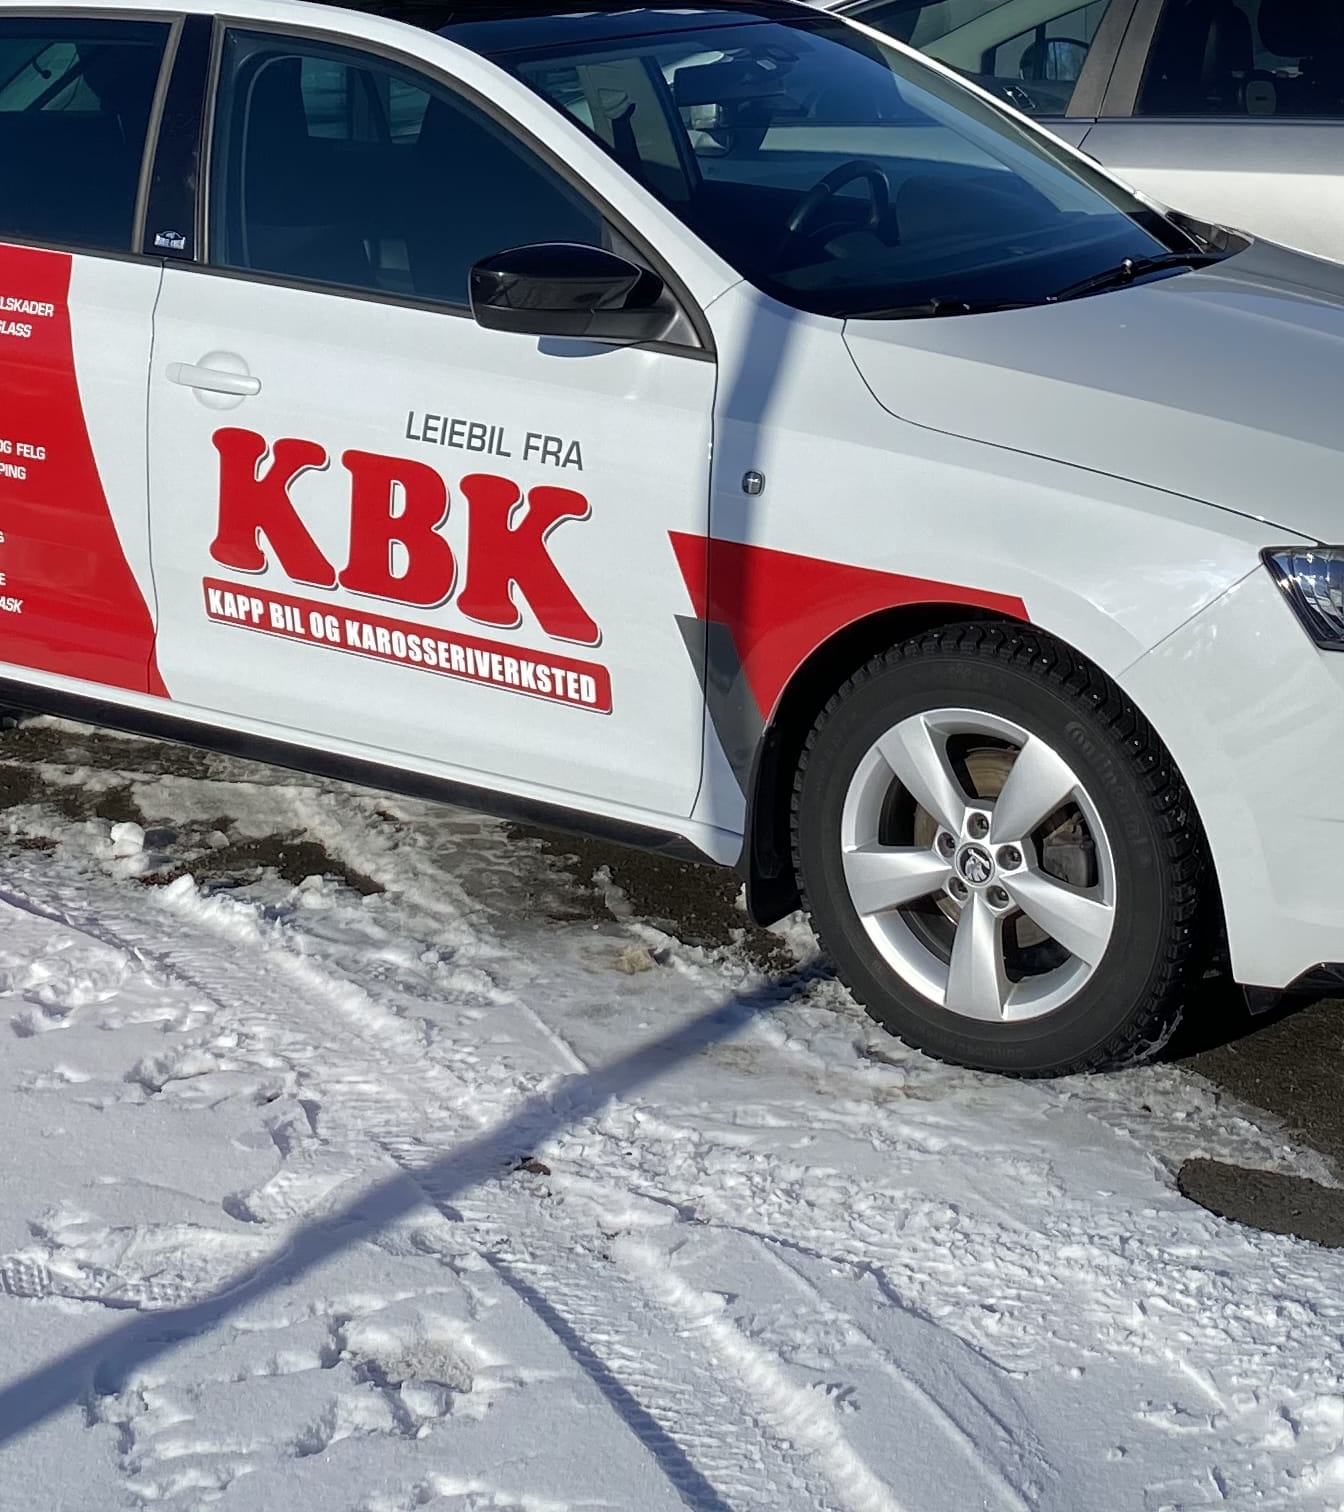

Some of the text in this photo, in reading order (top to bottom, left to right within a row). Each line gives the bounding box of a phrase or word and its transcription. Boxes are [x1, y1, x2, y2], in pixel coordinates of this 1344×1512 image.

[16, 443, 47, 461] FELG
[405, 410, 584, 471] LEIEBIL FRA
[209, 426, 602, 647] KBK
[208, 587, 597, 705] KAPP BIL OG KAROSSERIVERKSTED
